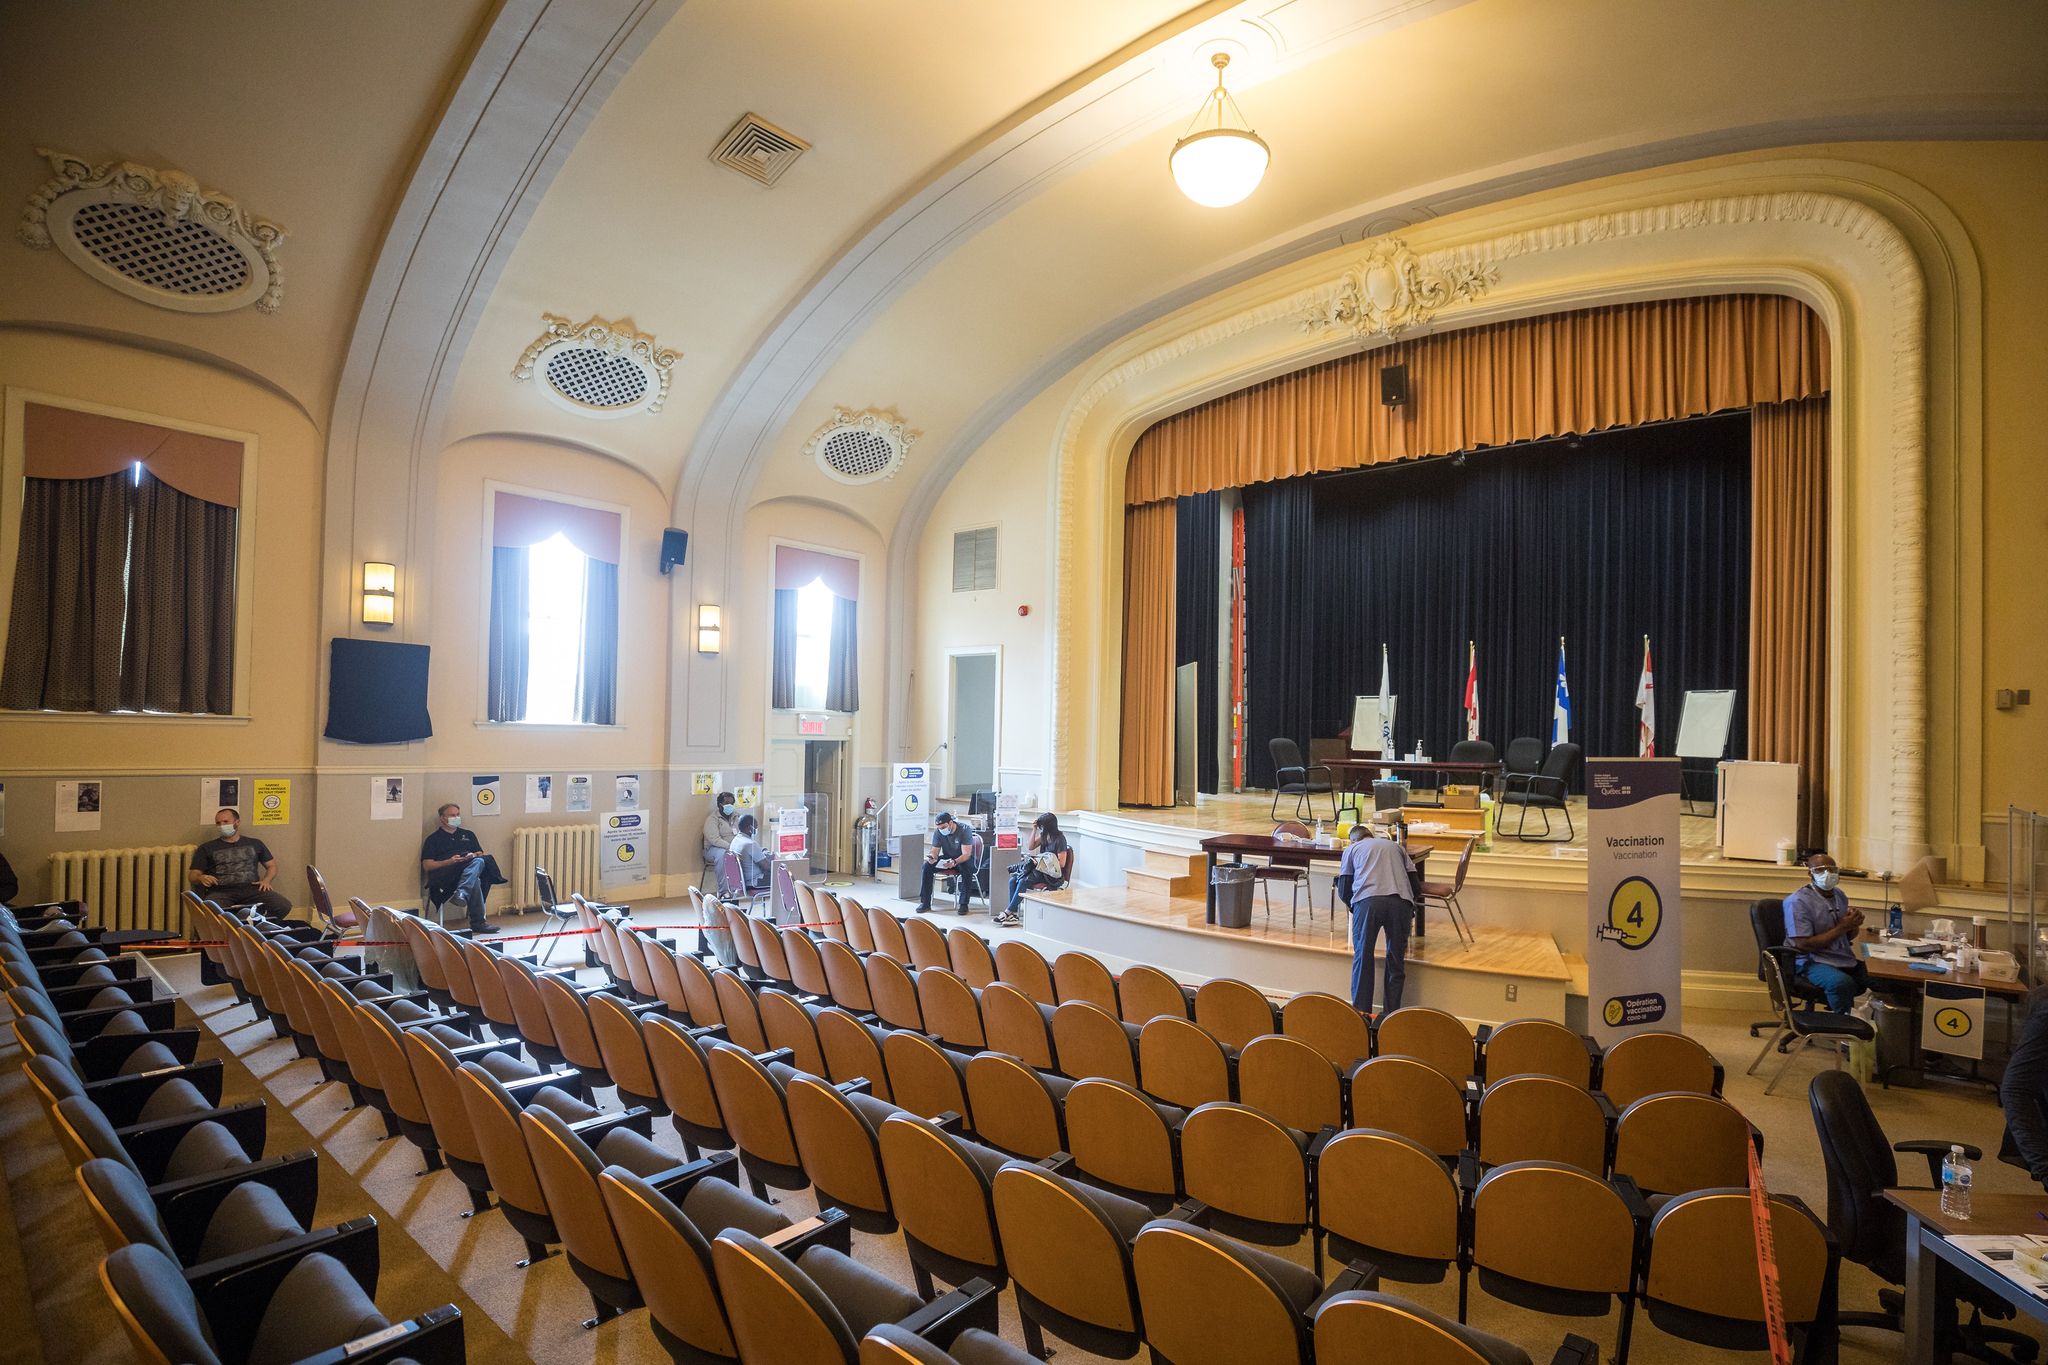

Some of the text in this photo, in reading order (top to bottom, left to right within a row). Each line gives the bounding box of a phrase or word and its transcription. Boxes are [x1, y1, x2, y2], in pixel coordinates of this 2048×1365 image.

[1606, 835, 1665, 848] Vaccination
[1613, 850, 1658, 860] Vaccination
[1627, 901, 1644, 928] 4
[1626, 998, 1658, 1008] Opération
[1626, 1004, 1662, 1015] vaccination
[1946, 1018, 1958, 1029] 4
